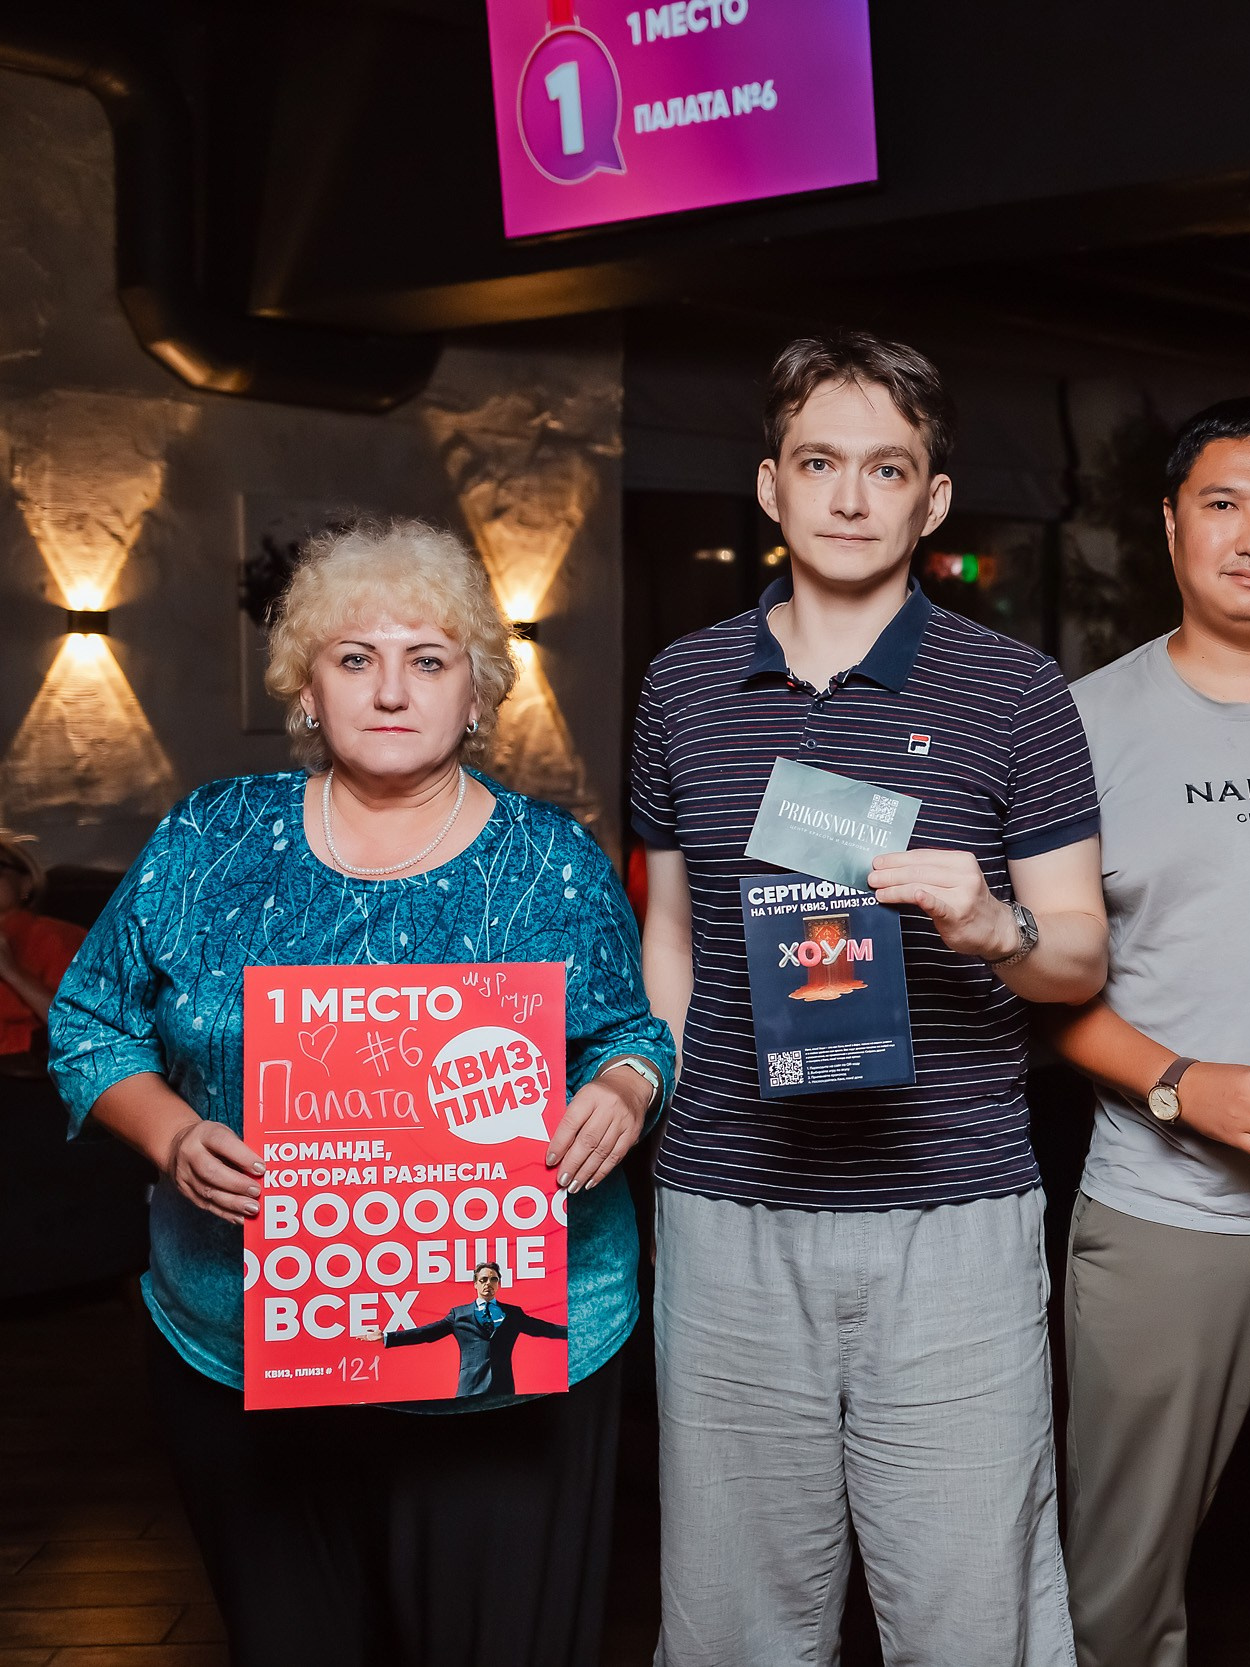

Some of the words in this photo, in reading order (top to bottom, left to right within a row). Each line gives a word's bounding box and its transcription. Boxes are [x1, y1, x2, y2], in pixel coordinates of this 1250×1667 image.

[626, 11, 642, 45] 1
[645, 0, 749, 42] МЕСТО
[544, 60, 585, 156] 1
[633, 88, 731, 134] ПАЛАТА
[731, 79, 778, 116] №6
[777, 799, 892, 849] PRIKOSNOVENIE
[748, 880, 870, 905] СЕРТИФИ
[751, 907, 766, 917] НА
[767, 906, 772, 916] 1
[774, 904, 799, 914] ИГРУ
[800, 901, 829, 913] КВИЗ,
[830, 899, 860, 909] ПЛИЗ!
[861, 897, 880, 907] ХО
[778, 938, 874, 968] ХОУМ
[266, 988, 285, 1023] 1
[301, 985, 463, 1023] МЕСТО
[429, 1040, 544, 1096] КВИЗ,
[258, 1059, 422, 1124] Палата
[434, 1070, 552, 1129] ПЛИЗ!
[263, 1140, 393, 1163] КОМАНДЕ,
[263, 1166, 378, 1188] КОТОРАЯ
[383, 1162, 508, 1184] РАЗНЕСЛА
[264, 1290, 420, 1342] ВСЕХ
[264, 1369, 293, 1379] КВИЗ,
[295, 1367, 324, 1377] ПЛИЗ!
[337, 1355, 380, 1382] 121
